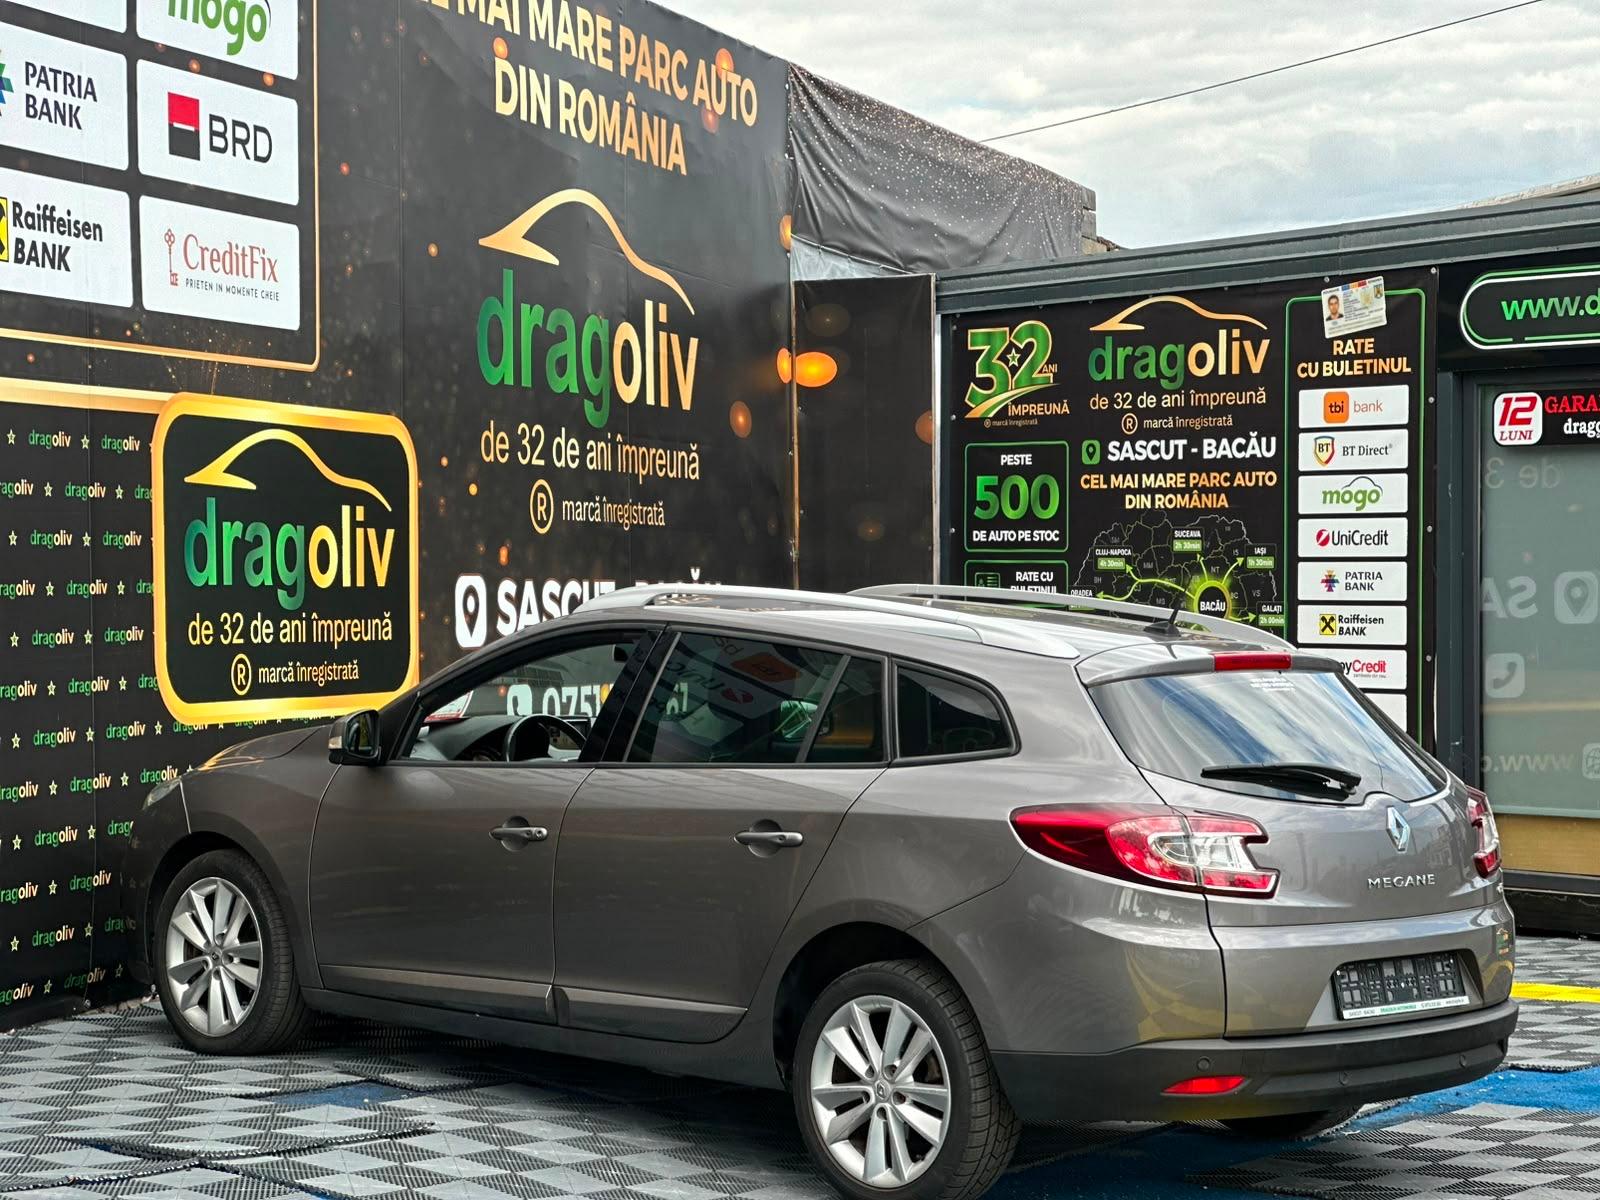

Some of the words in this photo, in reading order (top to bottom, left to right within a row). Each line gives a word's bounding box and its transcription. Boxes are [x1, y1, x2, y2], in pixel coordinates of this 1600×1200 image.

[529, 0, 614, 72] MARE
[619, 24, 689, 101] PARC
[693, 59, 757, 127] AUTO
[25, 61, 98, 102] PATRIA
[25, 94, 83, 130] BANK
[495, 57, 551, 129] DIN
[558, 79, 687, 176] ROMÂNIA
[208, 114, 273, 164] BRD
[12, 201, 103, 242] Raiffeisen
[13, 237, 71, 272] BANK
[183, 233, 279, 283] CreditFix
[185, 278, 213, 291] PRIETEN
[215, 283, 223, 293] IN
[225, 285, 258, 299] MOMENTE
[260, 289, 280, 301] CHEIE
[476, 268, 699, 429] dragoliv
[1333, 338, 1375, 355] RATE
[965, 320, 1053, 409] 32
[1042, 364, 1058, 374] ANI
[1088, 328, 1270, 390] dragoliv
[1297, 362, 1319, 378] CU
[1323, 357, 1411, 377] BULETINUL
[1008, 399, 1070, 416] ÎMPREUNĂ
[1089, 395, 1109, 410] de
[1113, 393, 1133, 409] 32
[1137, 392, 1155, 408] de
[1161, 391, 1185, 407] ani
[1189, 387, 1267, 409] împreună
[1328, 401, 1344, 414] tbi
[1353, 400, 1383, 413] bank
[1544, 394, 1600, 414] GARA
[1143, 416, 1173, 429] marcă
[1175, 414, 1233, 430] înregistrată
[1498, 396, 1538, 426] 12
[28, 429, 71, 450] dragoliv
[101, 435, 140, 454] dragoliv
[1107, 439, 1188, 462] SASCUT
[1202, 431, 1277, 460] BACĂU
[1499, 430, 1534, 441] LUNI
[480, 420, 510, 464] de
[517, 422, 545, 466] 32
[552, 427, 580, 469] de
[586, 432, 612, 472] ani
[617, 434, 700, 484] împreună
[1318, 442, 1331, 454] BT
[1342, 446, 1357, 457] BT
[1000, 454, 1033, 466] PESTE
[65, 481, 106, 501] dragoliv
[1080, 474, 1108, 489] CEL
[1110, 473, 1140, 488] MAI
[1142, 472, 1186, 488] MARE
[1189, 472, 1230, 487] PARC
[1233, 471, 1277, 487] AUTO
[974, 474, 1060, 520] 500
[1125, 494, 1151, 509] DIN
[1155, 490, 1229, 509] ROMÂNIA
[1322, 489, 1381, 511] mogo
[562, 495, 601, 522] marcă
[603, 497, 666, 531] înregistrată
[30, 529, 72, 549] dragoliv
[102, 531, 142, 550] dragoliv
[973, 531, 987, 542] DE
[988, 530, 1014, 542] AUTO
[1016, 530, 1030, 541] PE
[1032, 530, 1060, 541] STOC
[1174, 530, 1201, 538] SUCEAVA
[1331, 529, 1389, 546] UniCredit
[184, 497, 395, 610] dragoliv
[1015, 571, 1039, 581] RATE
[1040, 571, 1054, 581] CU
[1345, 571, 1383, 581] PATRIA
[1345, 582, 1375, 591] BANK
[66, 579, 108, 599] dragoliv
[496, 578, 616, 636] SASC
[1200, 599, 1226, 612] BACĂU
[188, 613, 214, 646] de
[219, 612, 245, 645] 32
[250, 612, 274, 644] de
[279, 613, 307, 643] ani
[312, 612, 393, 649] împreună
[1338, 615, 1384, 625] Raiffeisen
[1338, 626, 1367, 636] BANK
[31, 628, 75, 649] dragoliv
[104, 625, 144, 645] dragoliv
[258, 660, 295, 683] marcă
[296, 659, 359, 687] înregistrată
[68, 676, 110, 695] dragoliv
[33, 727, 76, 748] dragoliv
[106, 721, 146, 741] dragoliv
[70, 772, 112, 794] dragoliv
[34, 825, 78, 848] dragoliv
[69, 870, 112, 892] dragoliv
[1367, 874, 1436, 889] MEGANE
[32, 925, 75, 947] dragoliv
[64, 968, 106, 989] dragoliv
